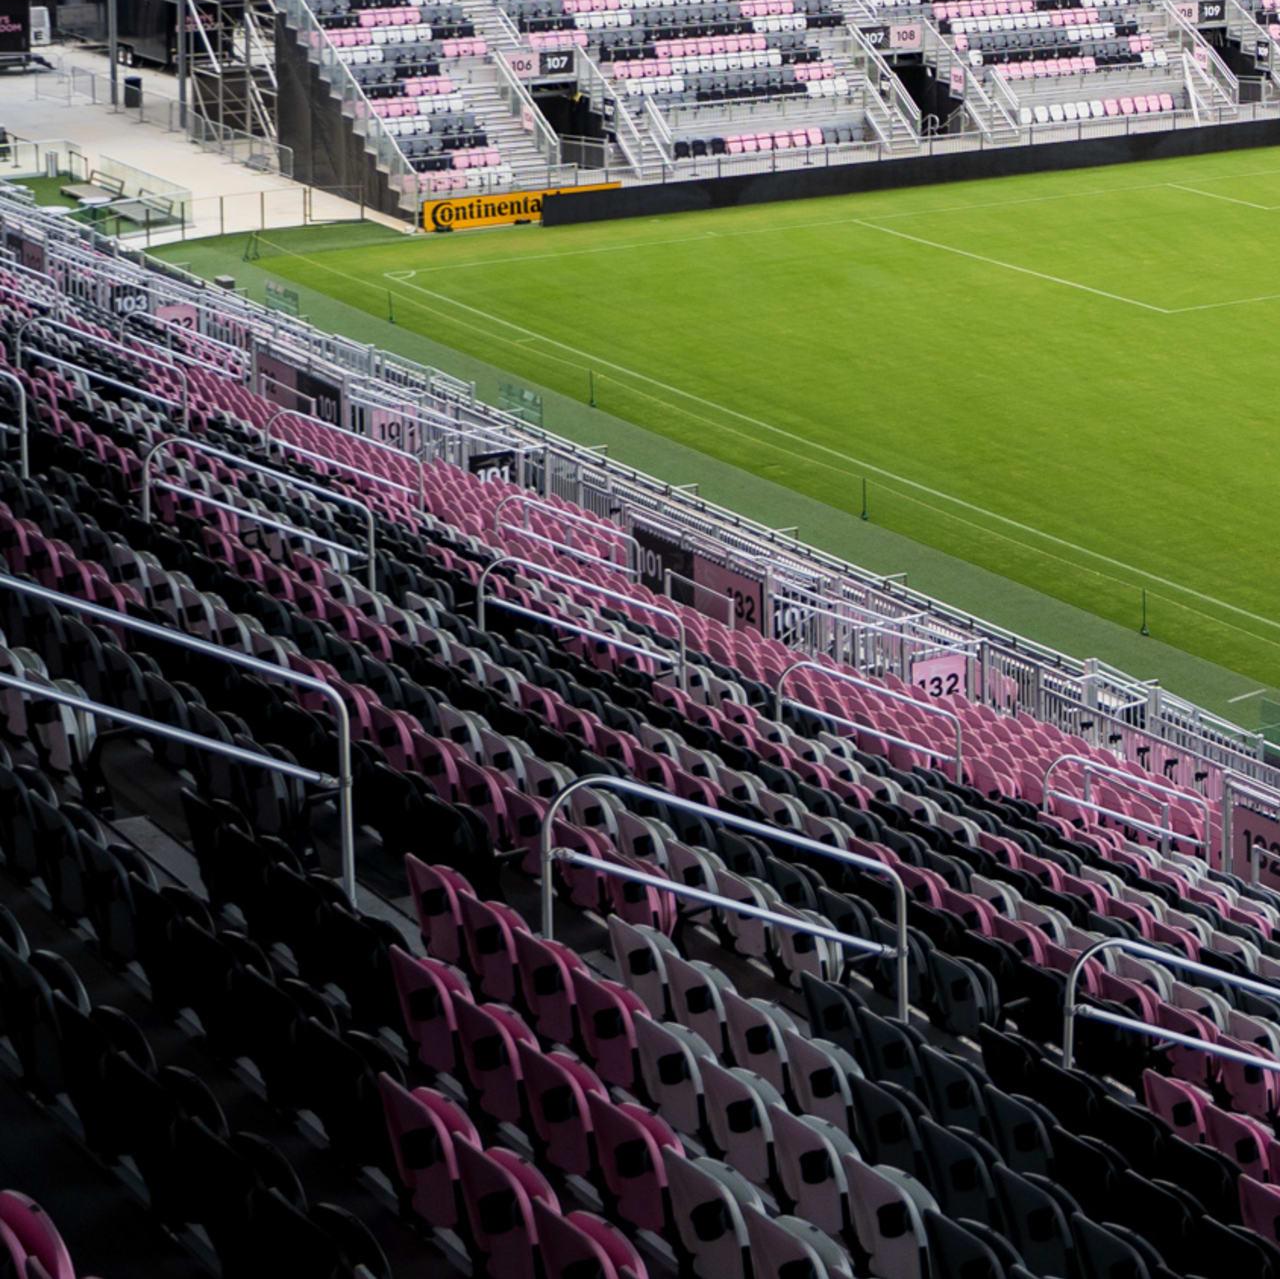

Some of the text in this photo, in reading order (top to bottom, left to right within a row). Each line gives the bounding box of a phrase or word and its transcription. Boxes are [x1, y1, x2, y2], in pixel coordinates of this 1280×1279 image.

[1203, 5, 1221, 17] 109
[897, 30, 916, 41] 108
[512, 60, 533, 73] 106
[546, 56, 569, 70] 107
[431, 196, 543, 228] Continenta
[115, 296, 148, 313] 103
[919, 672, 961, 698] 132
